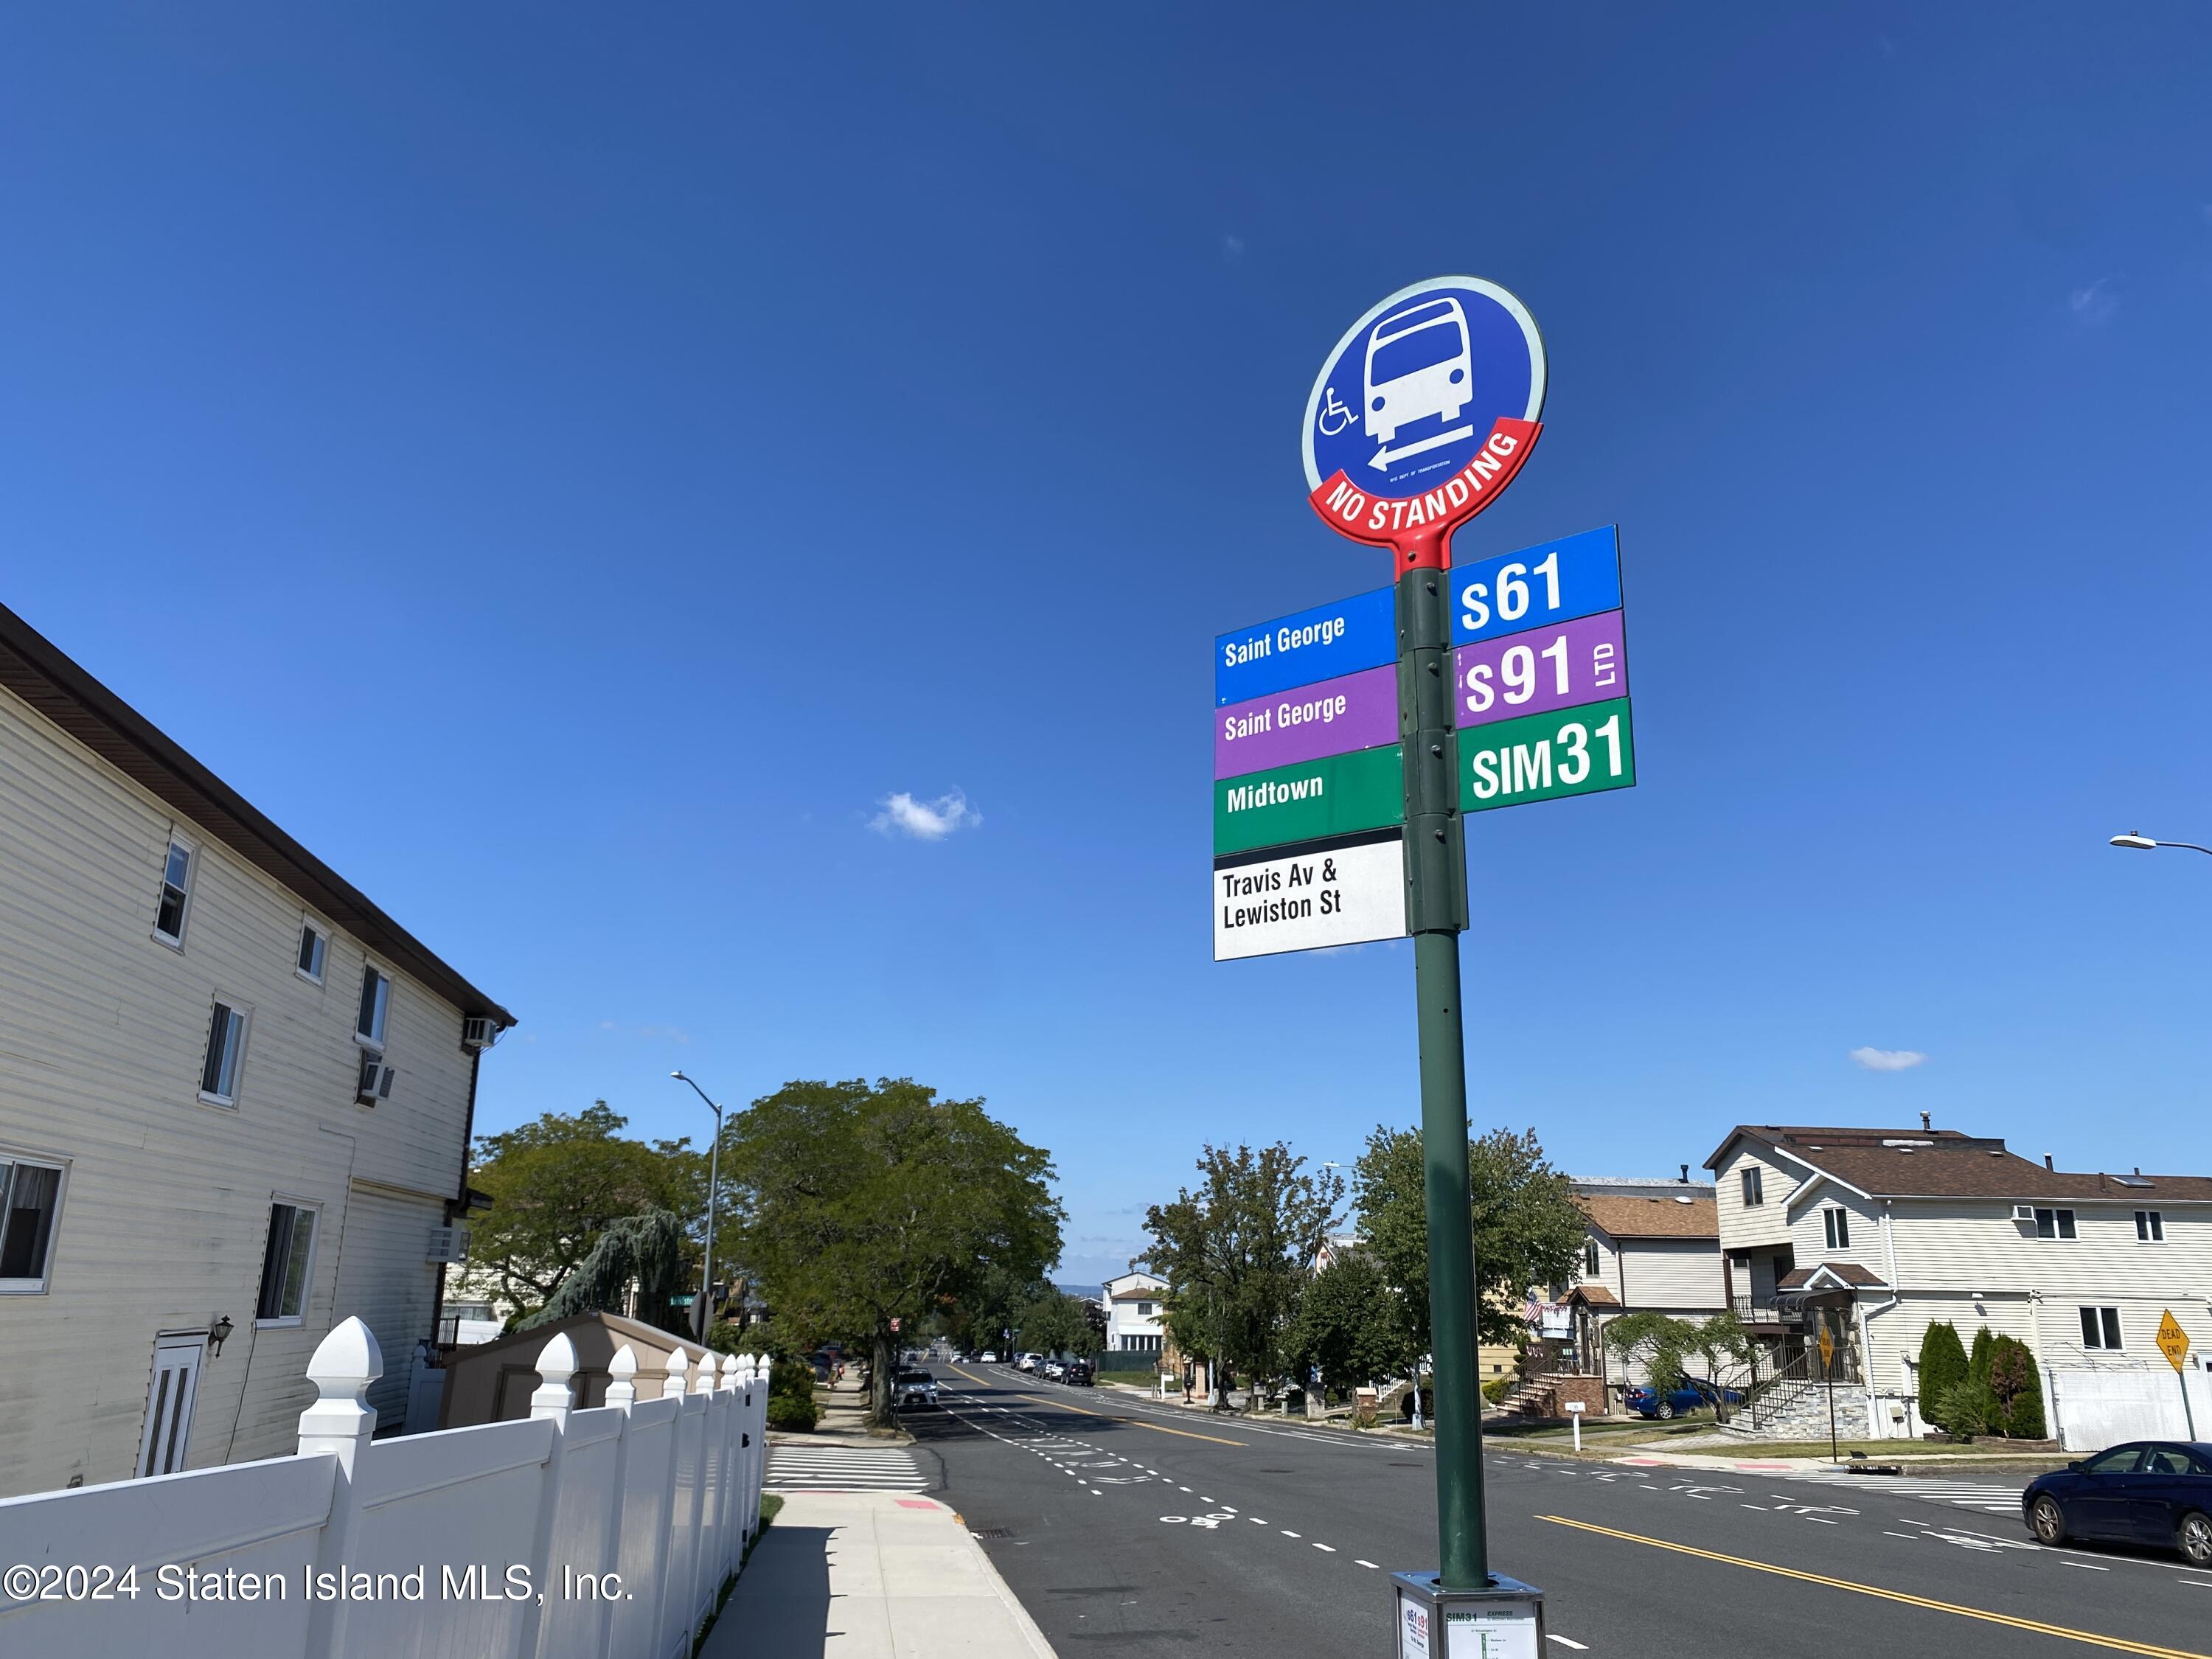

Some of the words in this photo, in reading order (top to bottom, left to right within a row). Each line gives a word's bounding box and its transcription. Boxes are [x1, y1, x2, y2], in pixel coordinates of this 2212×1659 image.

[1326, 481, 1366, 521] NO
[1368, 433, 1518, 530] STANDING
[1462, 552, 1560, 630] S61
[1225, 634, 1271, 667] Saint
[1277, 617, 1345, 652] George
[1466, 635, 1569, 712] S91
[1593, 643, 1615, 687] LTD
[1225, 709, 1272, 741] Saint
[1277, 695, 1346, 728] George
[1473, 714, 1622, 799] SIM31
[1228, 776, 1324, 813] Midtown
[1222, 872, 1281, 898] Travis
[1288, 863, 1314, 888] Av
[1322, 858, 1338, 883] &
[1224, 897, 1312, 929] Lewiston
[1320, 889, 1342, 915] St
[2161, 1329, 2180, 1340] DEAD
[2167, 1346, 2182, 1356] END
[1446, 1613, 1478, 1622] SIM31
